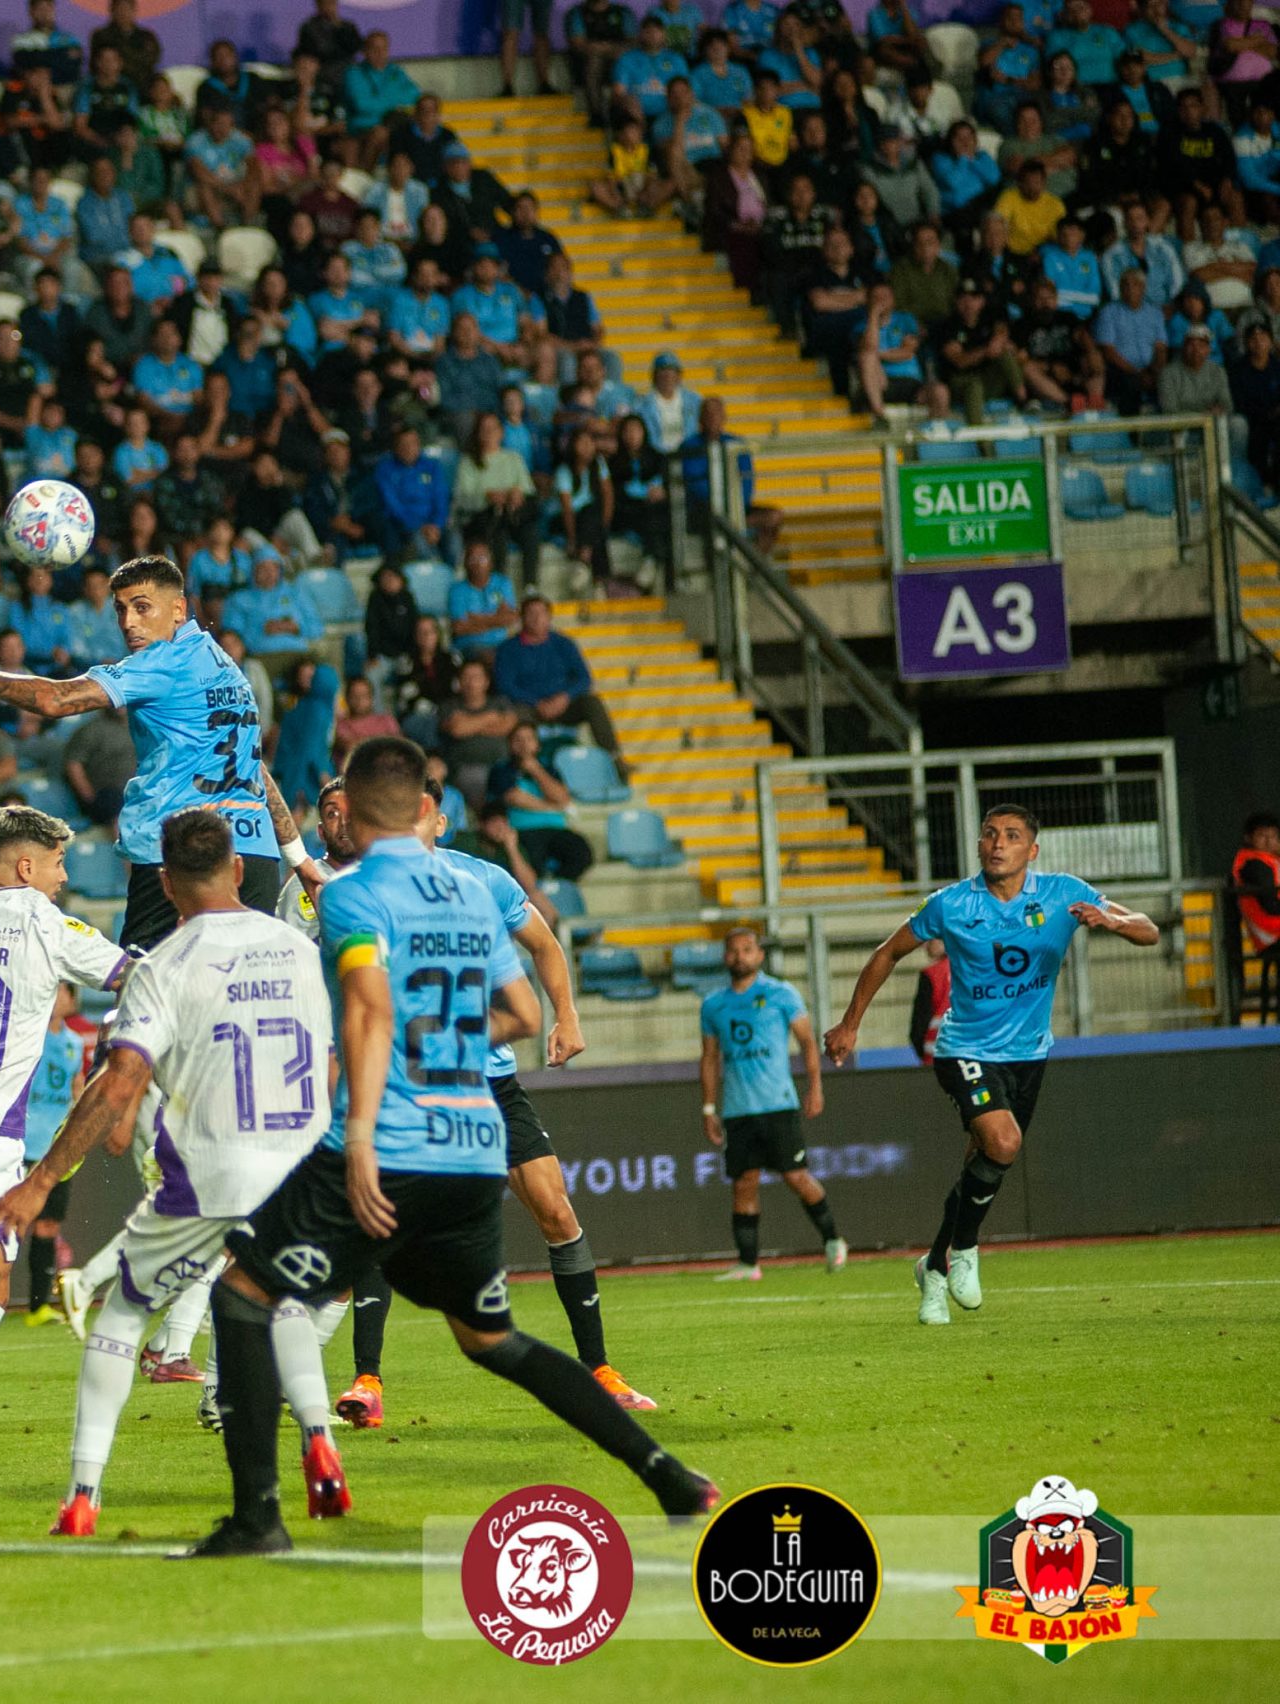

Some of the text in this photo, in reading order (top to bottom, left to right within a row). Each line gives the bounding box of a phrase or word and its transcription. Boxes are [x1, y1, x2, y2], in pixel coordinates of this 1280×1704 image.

[913, 480, 1031, 517] SALIDA
[948, 521, 998, 546] EXIT
[932, 581, 1037, 658] A3
[410, 932, 492, 958] ROBLEDO
[227, 979, 294, 1004] SUAREZ
[972, 974, 1050, 1001] BC.GAME
[404, 966, 489, 1088] 22
[213, 1017, 315, 1133] 13
[561, 1154, 677, 1195] YOUR
